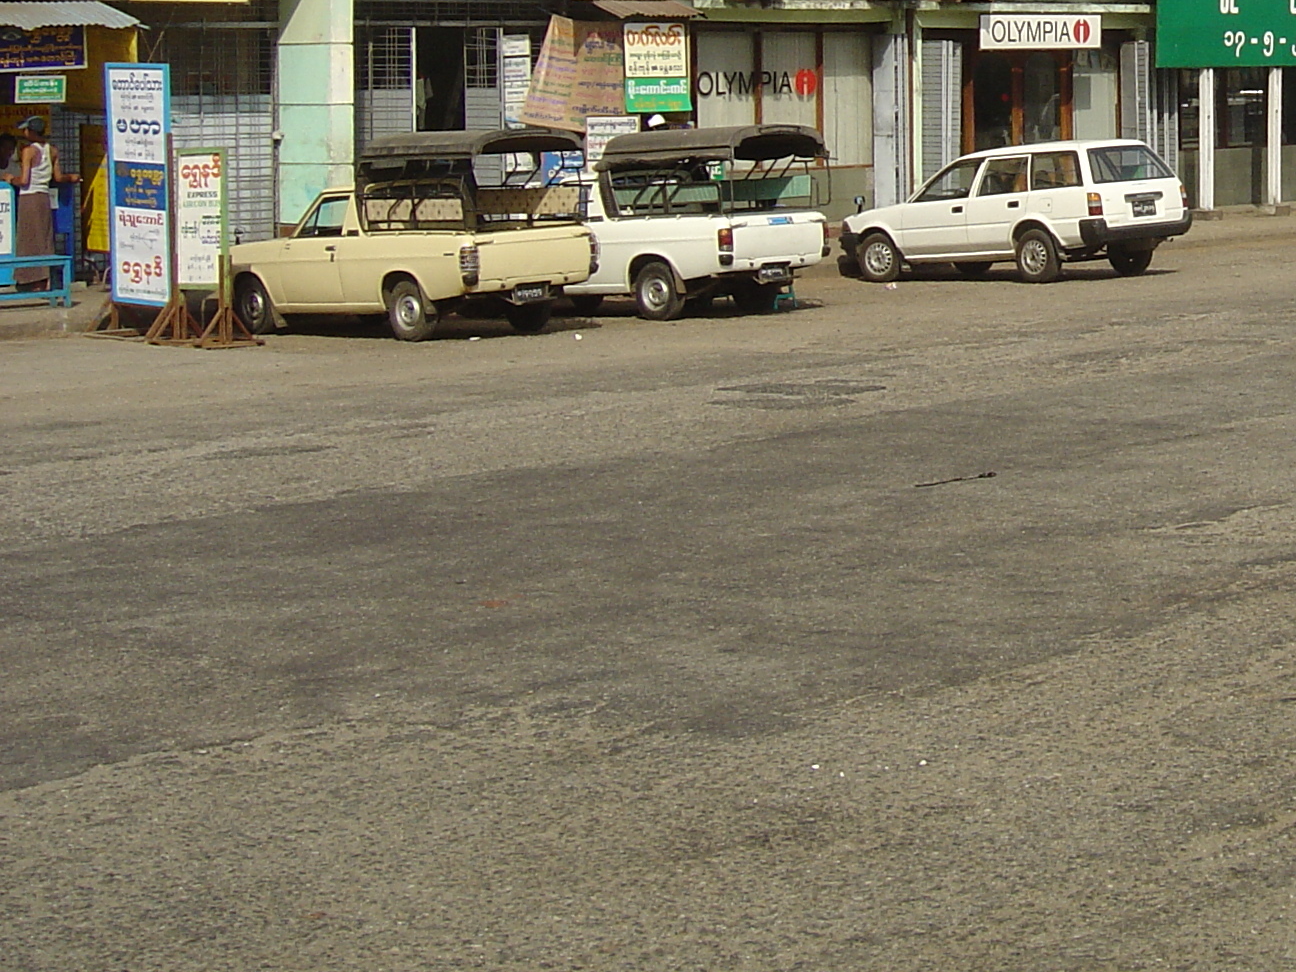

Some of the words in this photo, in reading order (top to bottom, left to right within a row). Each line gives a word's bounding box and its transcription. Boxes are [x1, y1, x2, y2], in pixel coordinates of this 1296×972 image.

[991, 20, 1071, 43] OLYMPIA
[697, 71, 793, 96] OLYMPIA
[187, 191, 218, 199] EXPRESS
